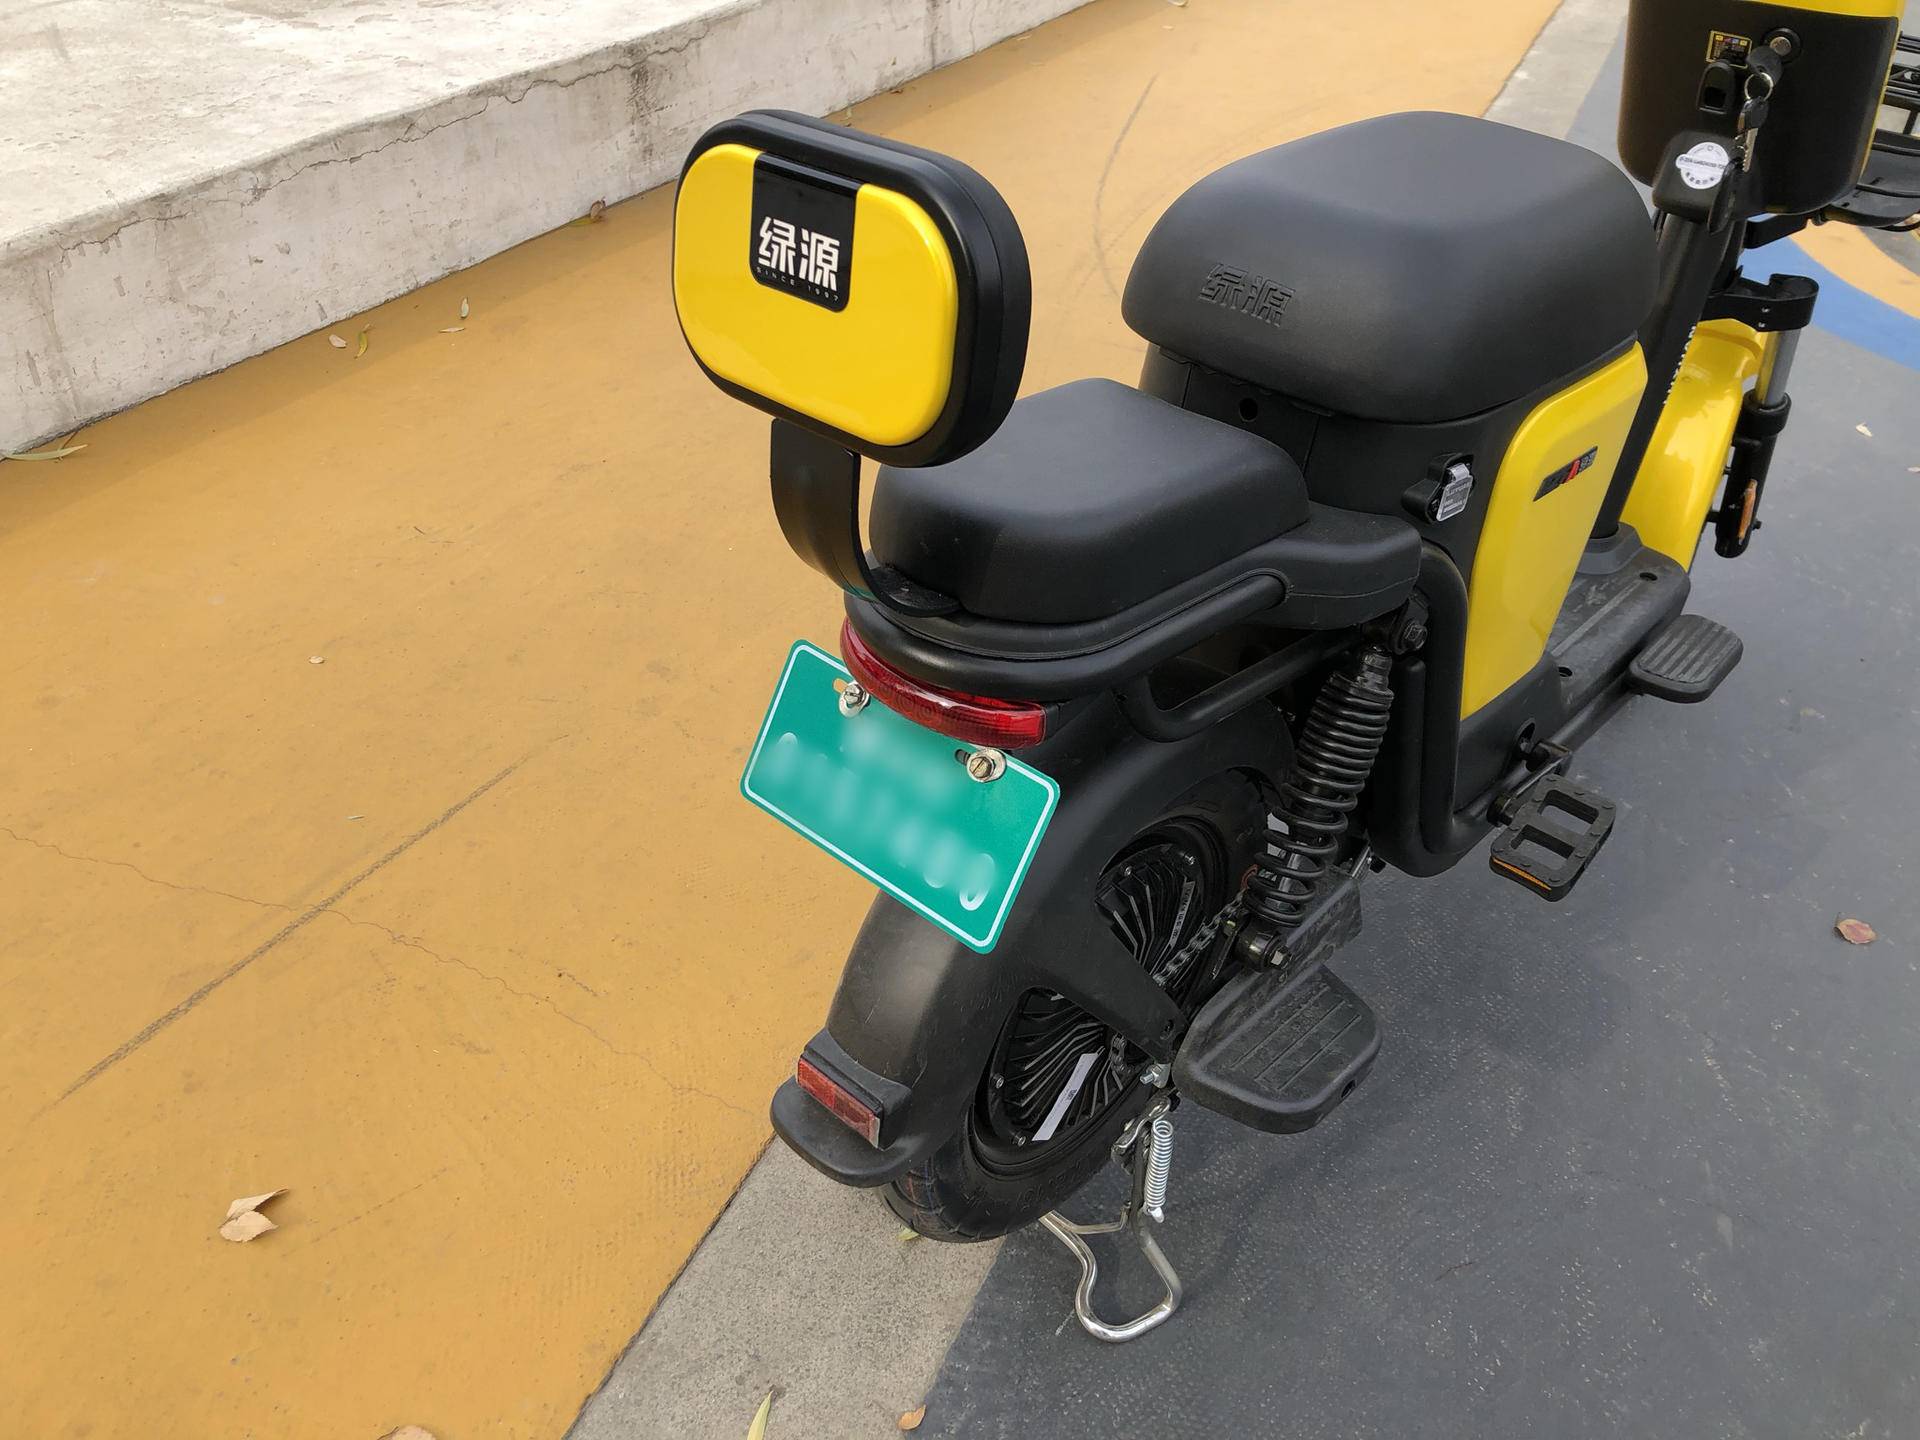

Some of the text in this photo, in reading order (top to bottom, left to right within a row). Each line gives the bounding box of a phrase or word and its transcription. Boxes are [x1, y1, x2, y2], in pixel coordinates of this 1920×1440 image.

[755, 266, 840, 302] SINCE 1997
[758, 216, 840, 291] 绿源
[1199, 262, 1296, 327] 绿源
